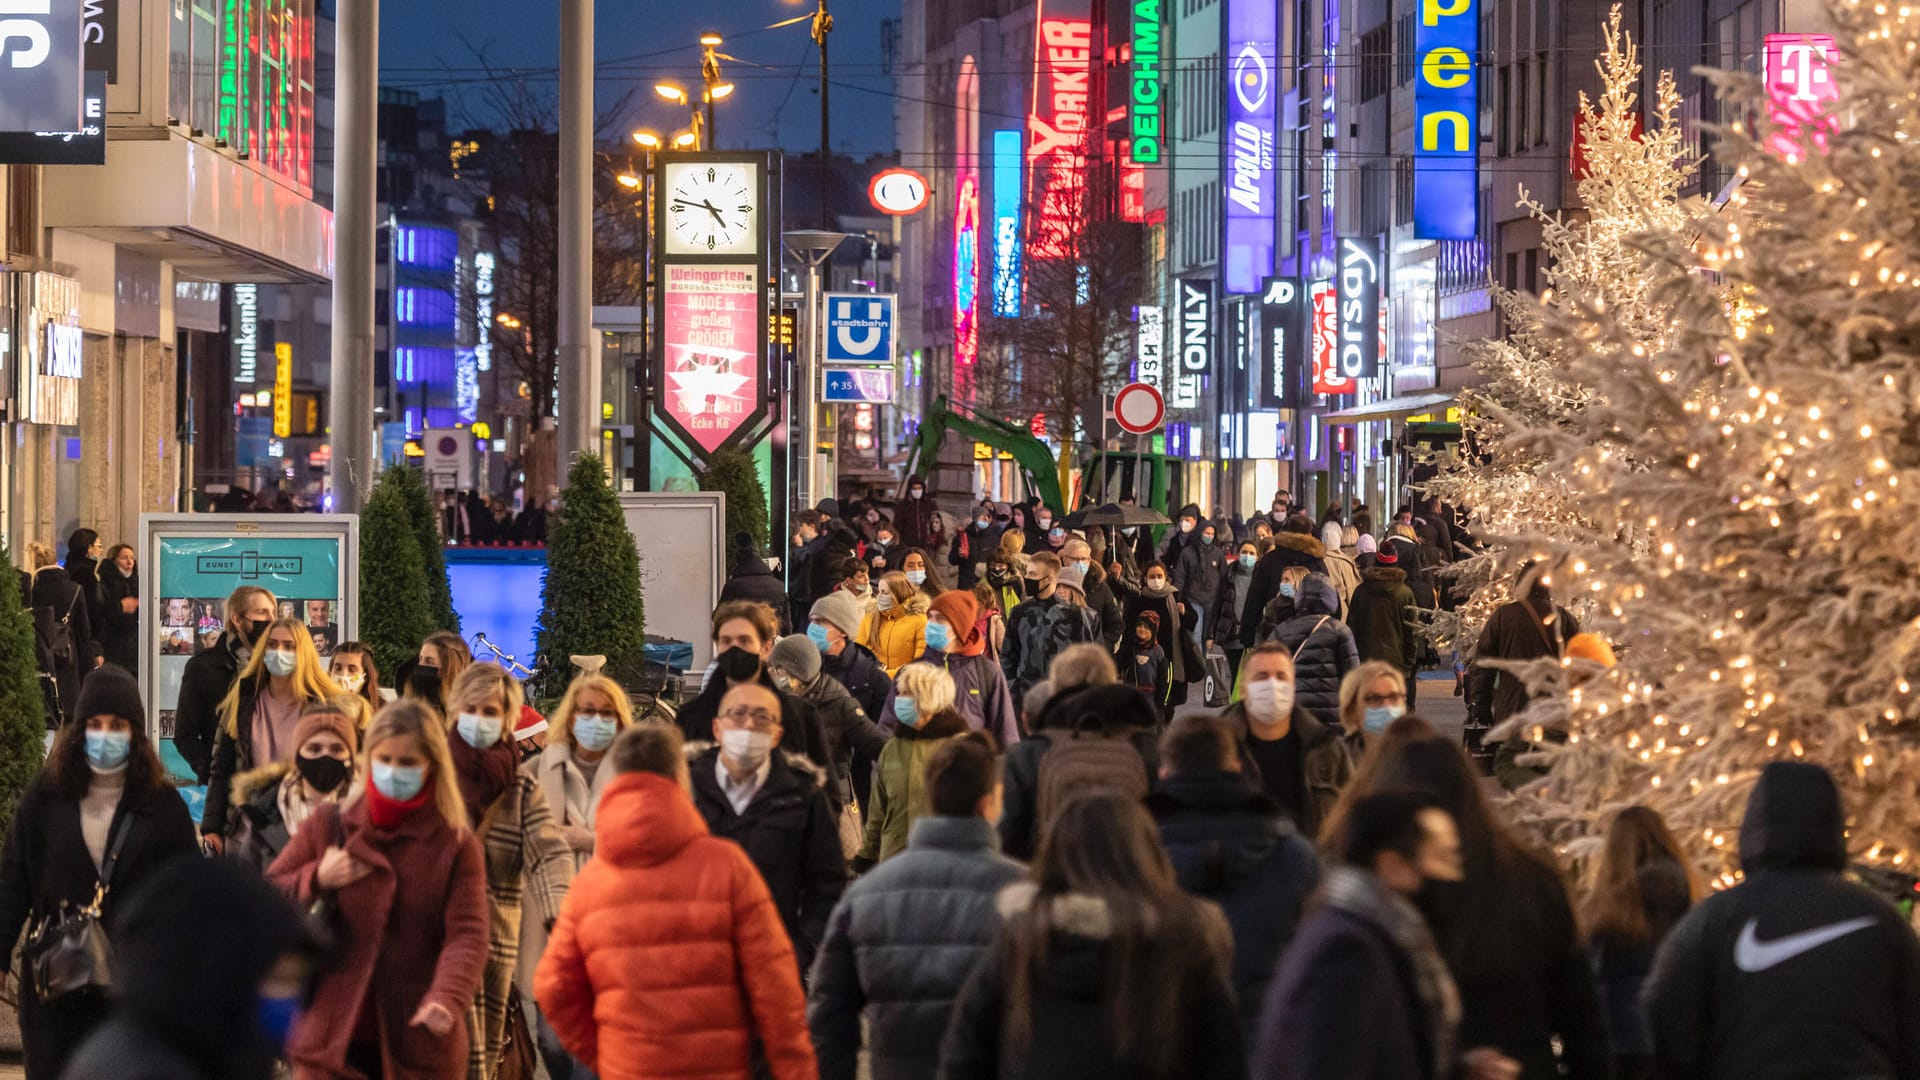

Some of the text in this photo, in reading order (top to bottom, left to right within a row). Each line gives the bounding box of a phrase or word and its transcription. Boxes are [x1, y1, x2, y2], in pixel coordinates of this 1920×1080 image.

[1028, 21, 1091, 160] YORKER
[1133, 0, 1160, 162] DEICHMA
[1422, 0, 1471, 151] pen
[1229, 121, 1261, 214] APOLLO
[1261, 130, 1273, 170] OPTIK
[688, 295, 735, 310] MODE in
[1263, 281, 1294, 304] JD
[1343, 238, 1376, 377] orsay
[691, 311, 731, 329] großen
[831, 319, 888, 328] stadtbahn
[837, 301, 882, 356] U
[1184, 284, 1207, 370] ONLY
[840, 381, 853, 391] 35
[1144, 344, 1158, 387] USH
[691, 417, 713, 429] Ecke
